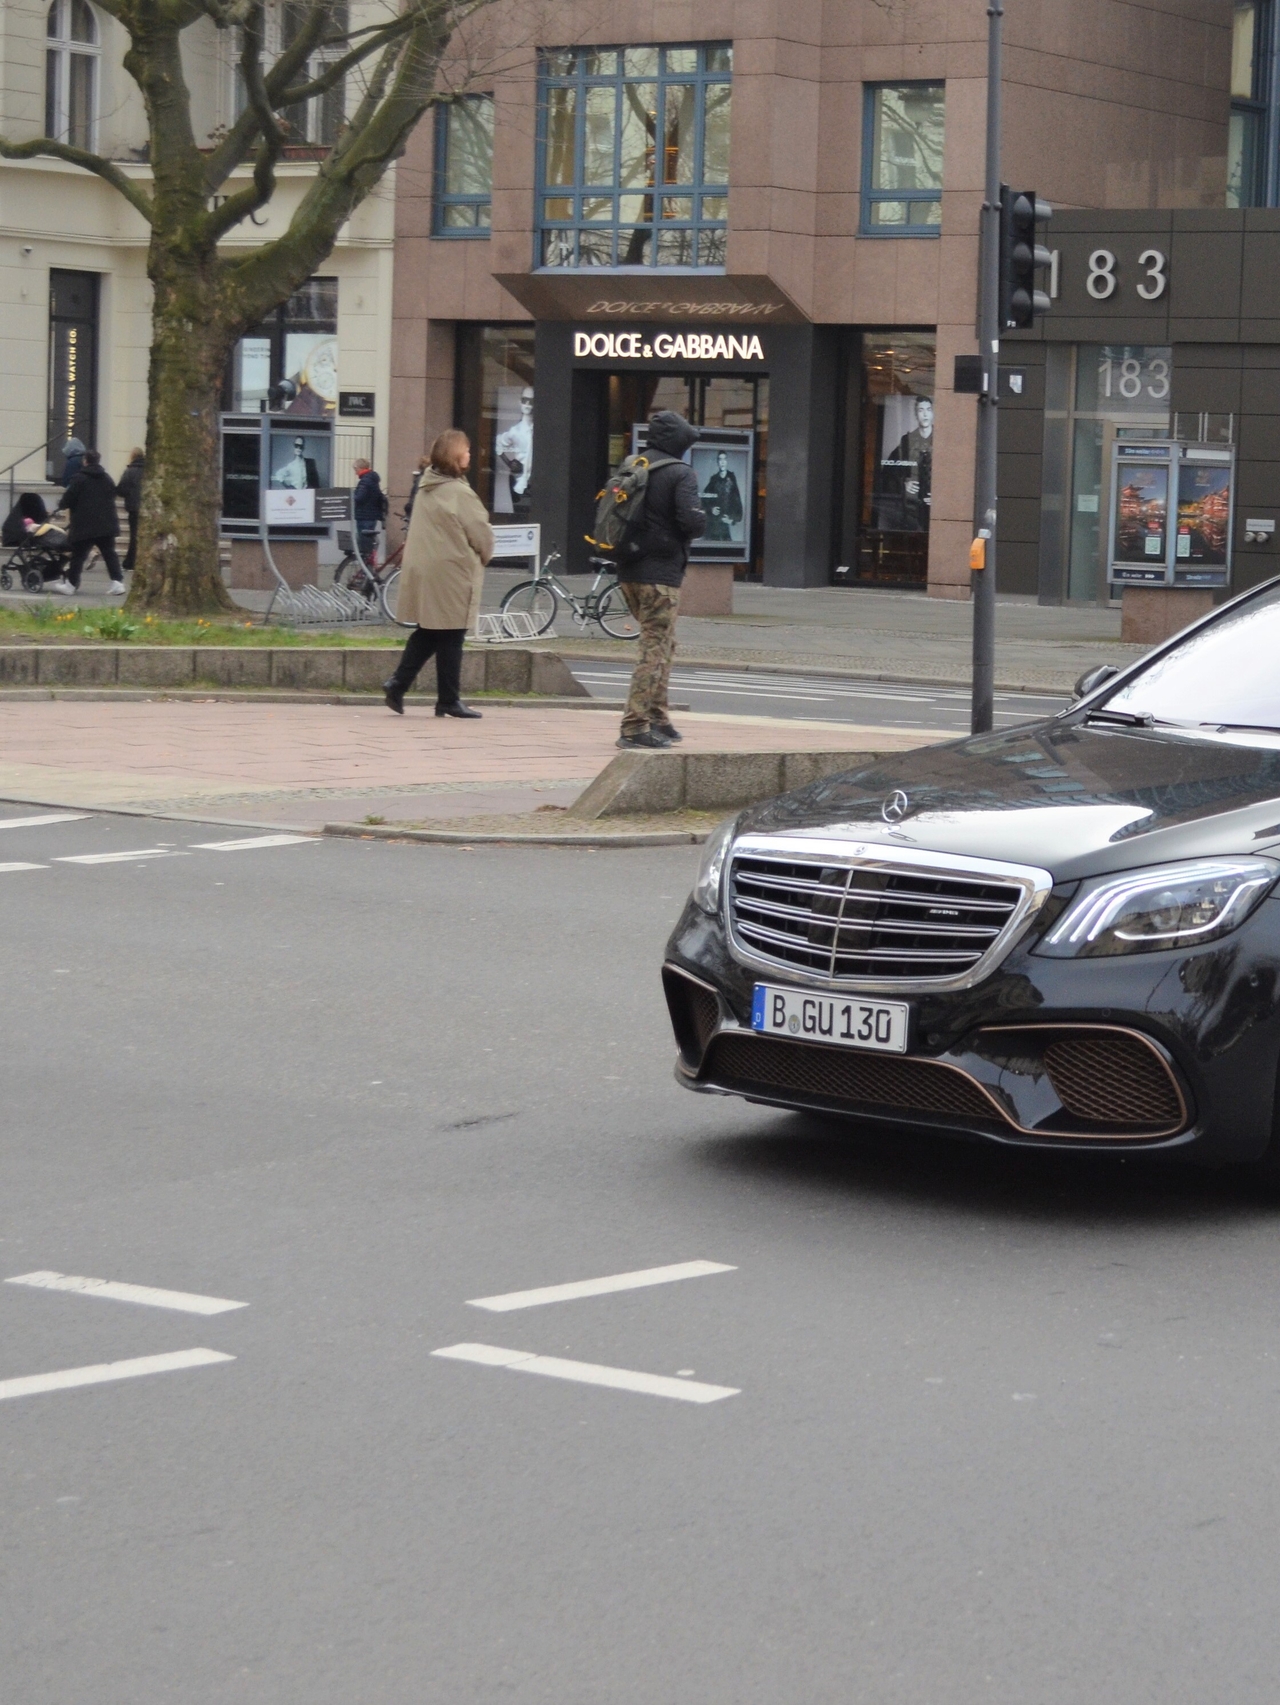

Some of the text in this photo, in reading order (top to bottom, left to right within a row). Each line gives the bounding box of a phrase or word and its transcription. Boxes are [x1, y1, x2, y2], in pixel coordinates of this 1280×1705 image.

[1050, 249, 1167, 299] 183
[68, 347, 76, 382] WATCH
[1098, 359, 1170, 398] 183
[772, 994, 786, 1029] B
